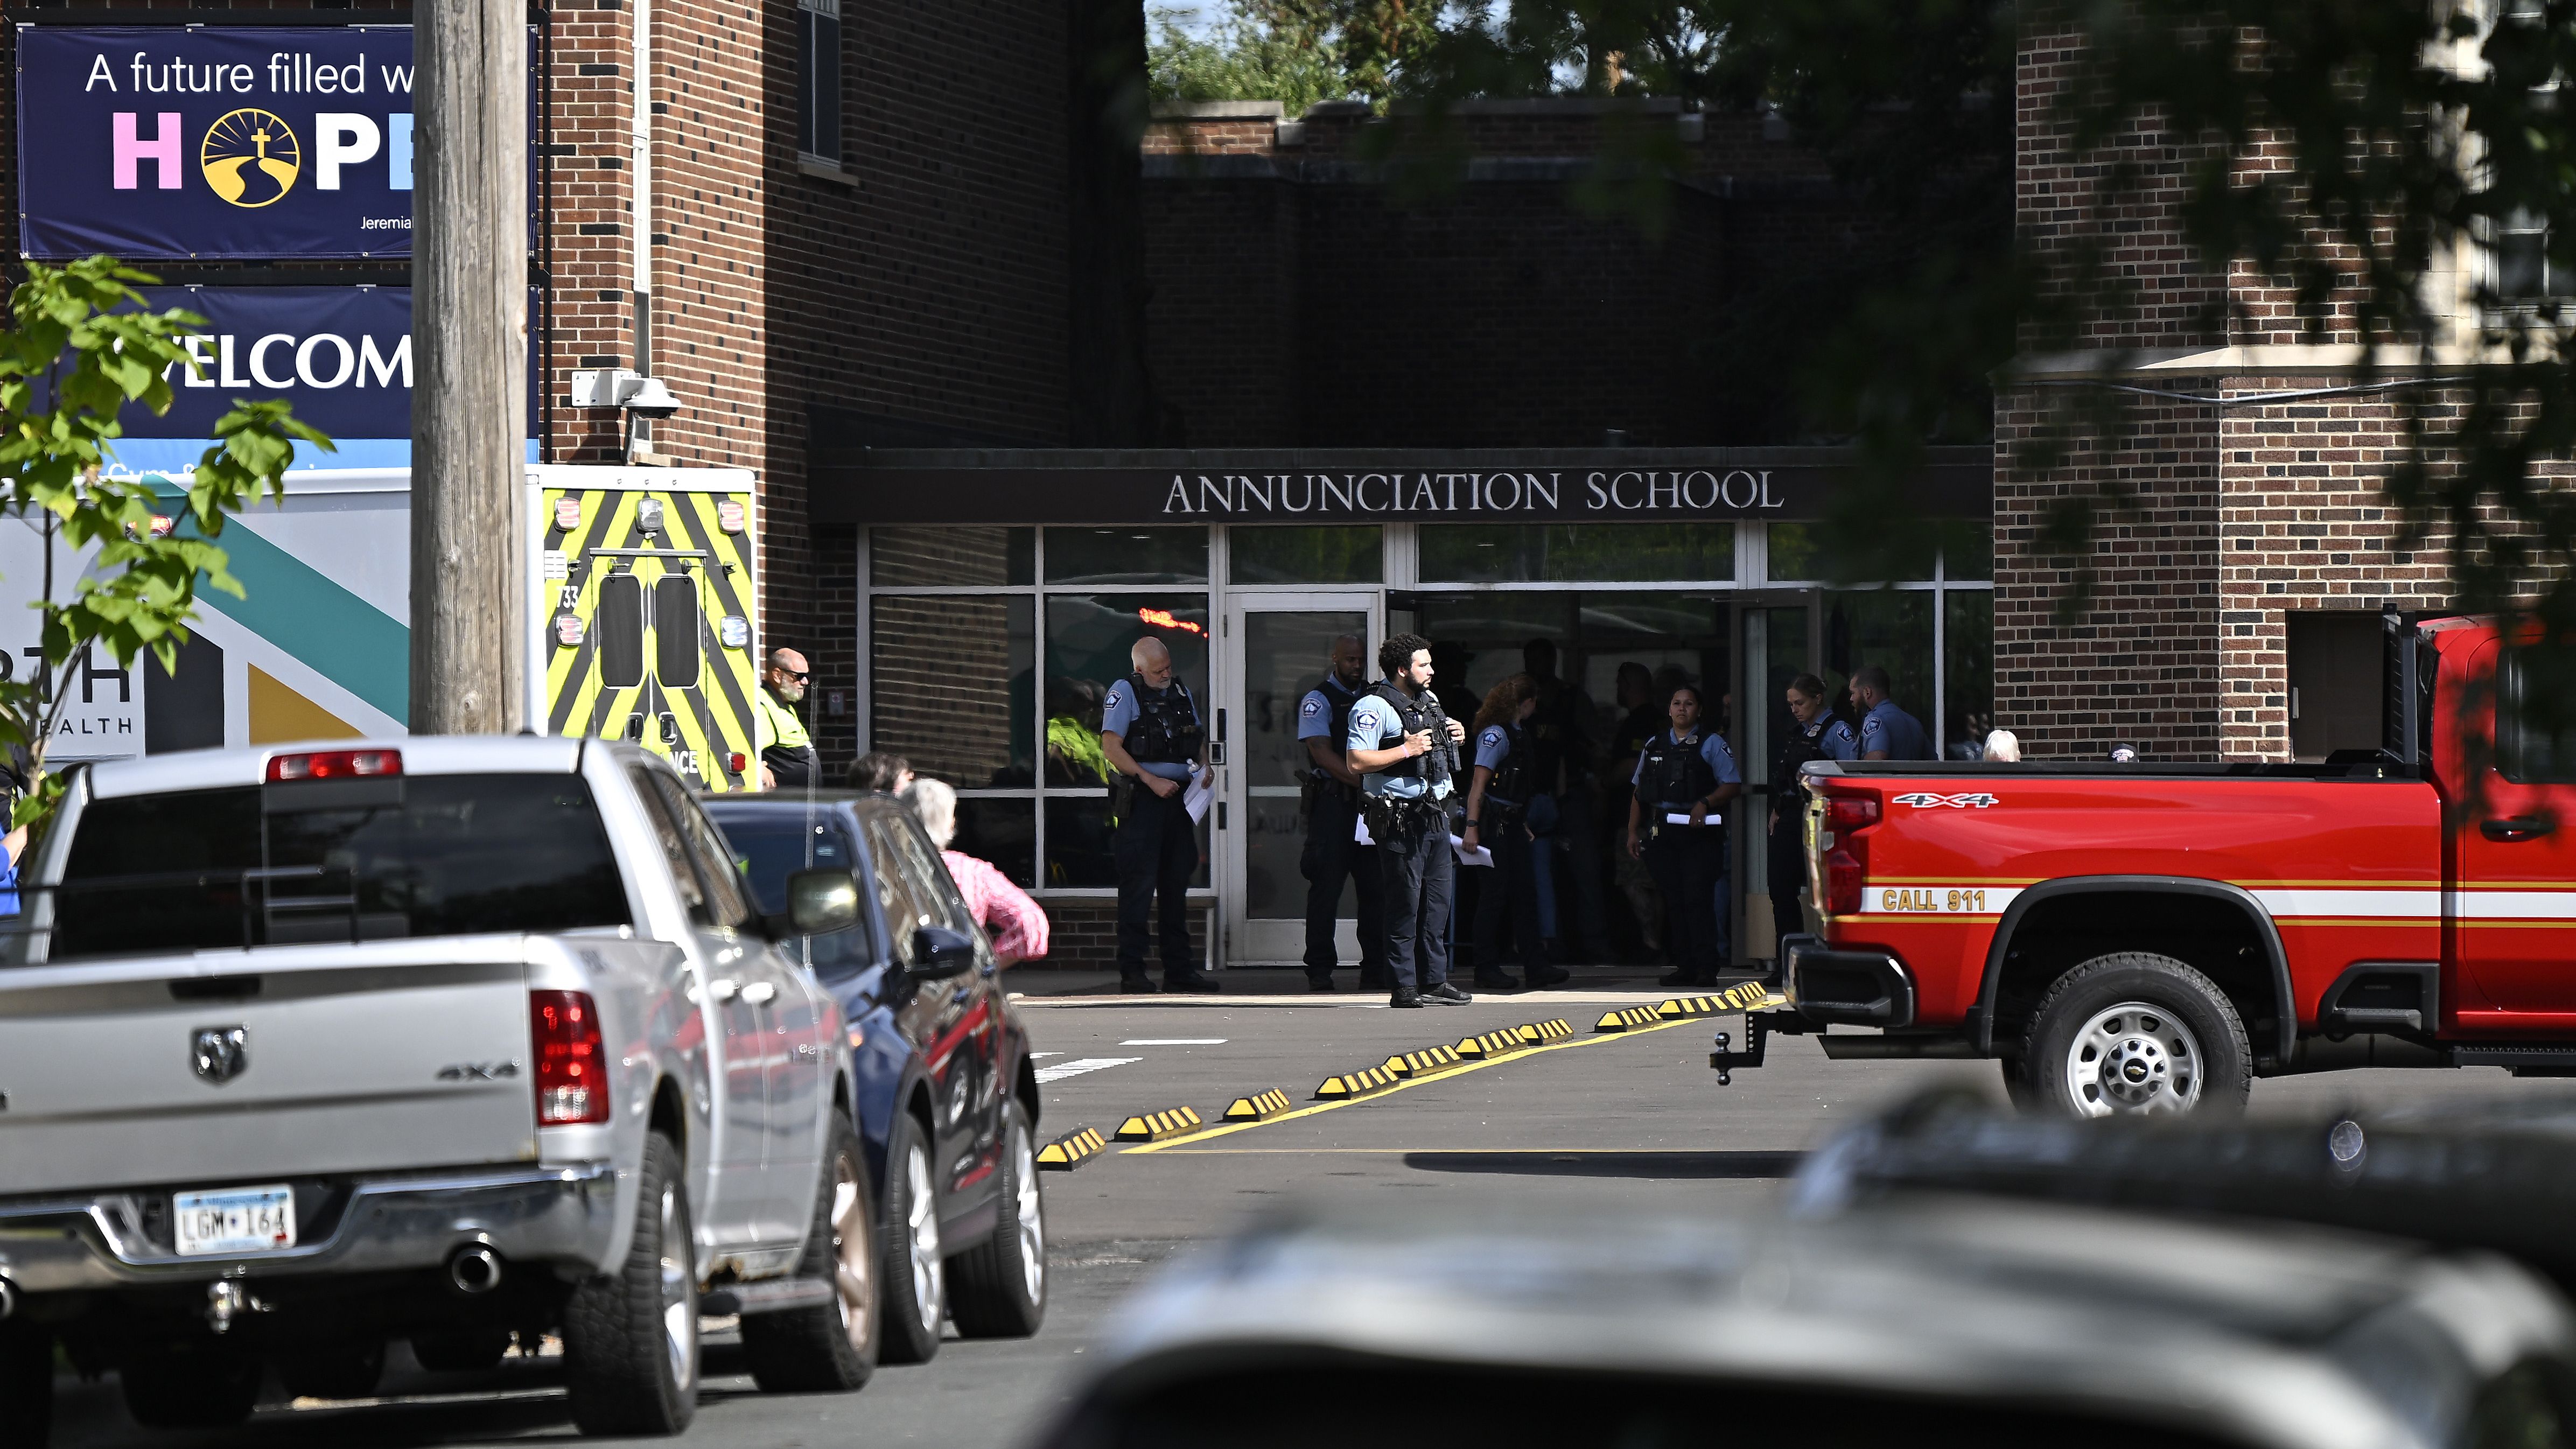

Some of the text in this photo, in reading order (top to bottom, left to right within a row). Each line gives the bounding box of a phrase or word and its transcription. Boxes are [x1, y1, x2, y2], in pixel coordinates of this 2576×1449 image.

[85, 54, 117, 92] A
[130, 52, 254, 93] future
[267, 52, 365, 94] filled
[161, 333, 413, 388] ELCOM
[1161, 470, 1785, 513] ANNUNCIATION SCHOOL
[26, 717, 131, 735] EALTH
[668, 750, 699, 775] NCE
[1882, 889, 1985, 911] CALL 911
